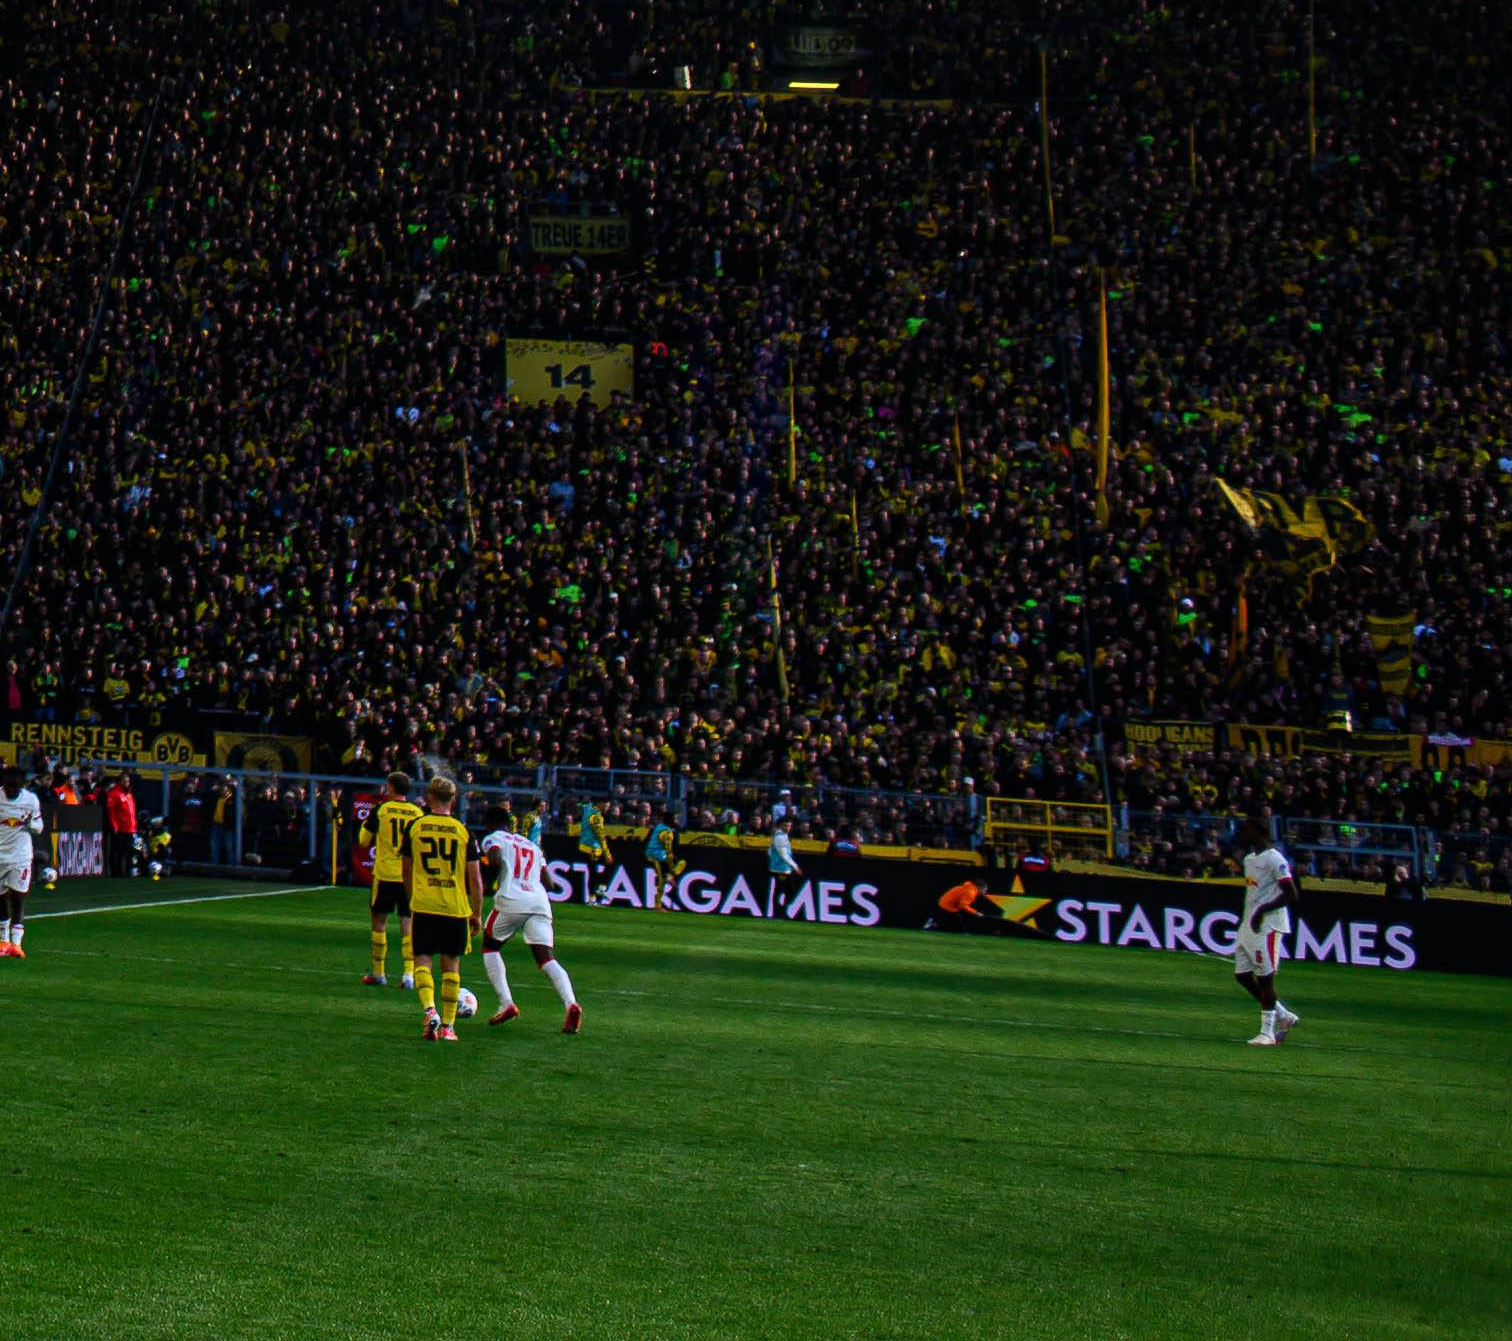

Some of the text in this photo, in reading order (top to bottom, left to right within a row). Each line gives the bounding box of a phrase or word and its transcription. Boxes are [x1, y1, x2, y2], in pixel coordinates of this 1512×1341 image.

[532, 222, 629, 249] TREUE 14ER
[545, 363, 596, 389] 14
[10, 721, 145, 751] RENNSTEIG
[157, 735, 190, 764] BVB
[58, 830, 103, 877] STARGAMES
[419, 836, 459, 875] 24
[513, 843, 535, 880] 17
[547, 860, 881, 926] STARGAMES
[1055, 899, 1417, 970] STARGMES
